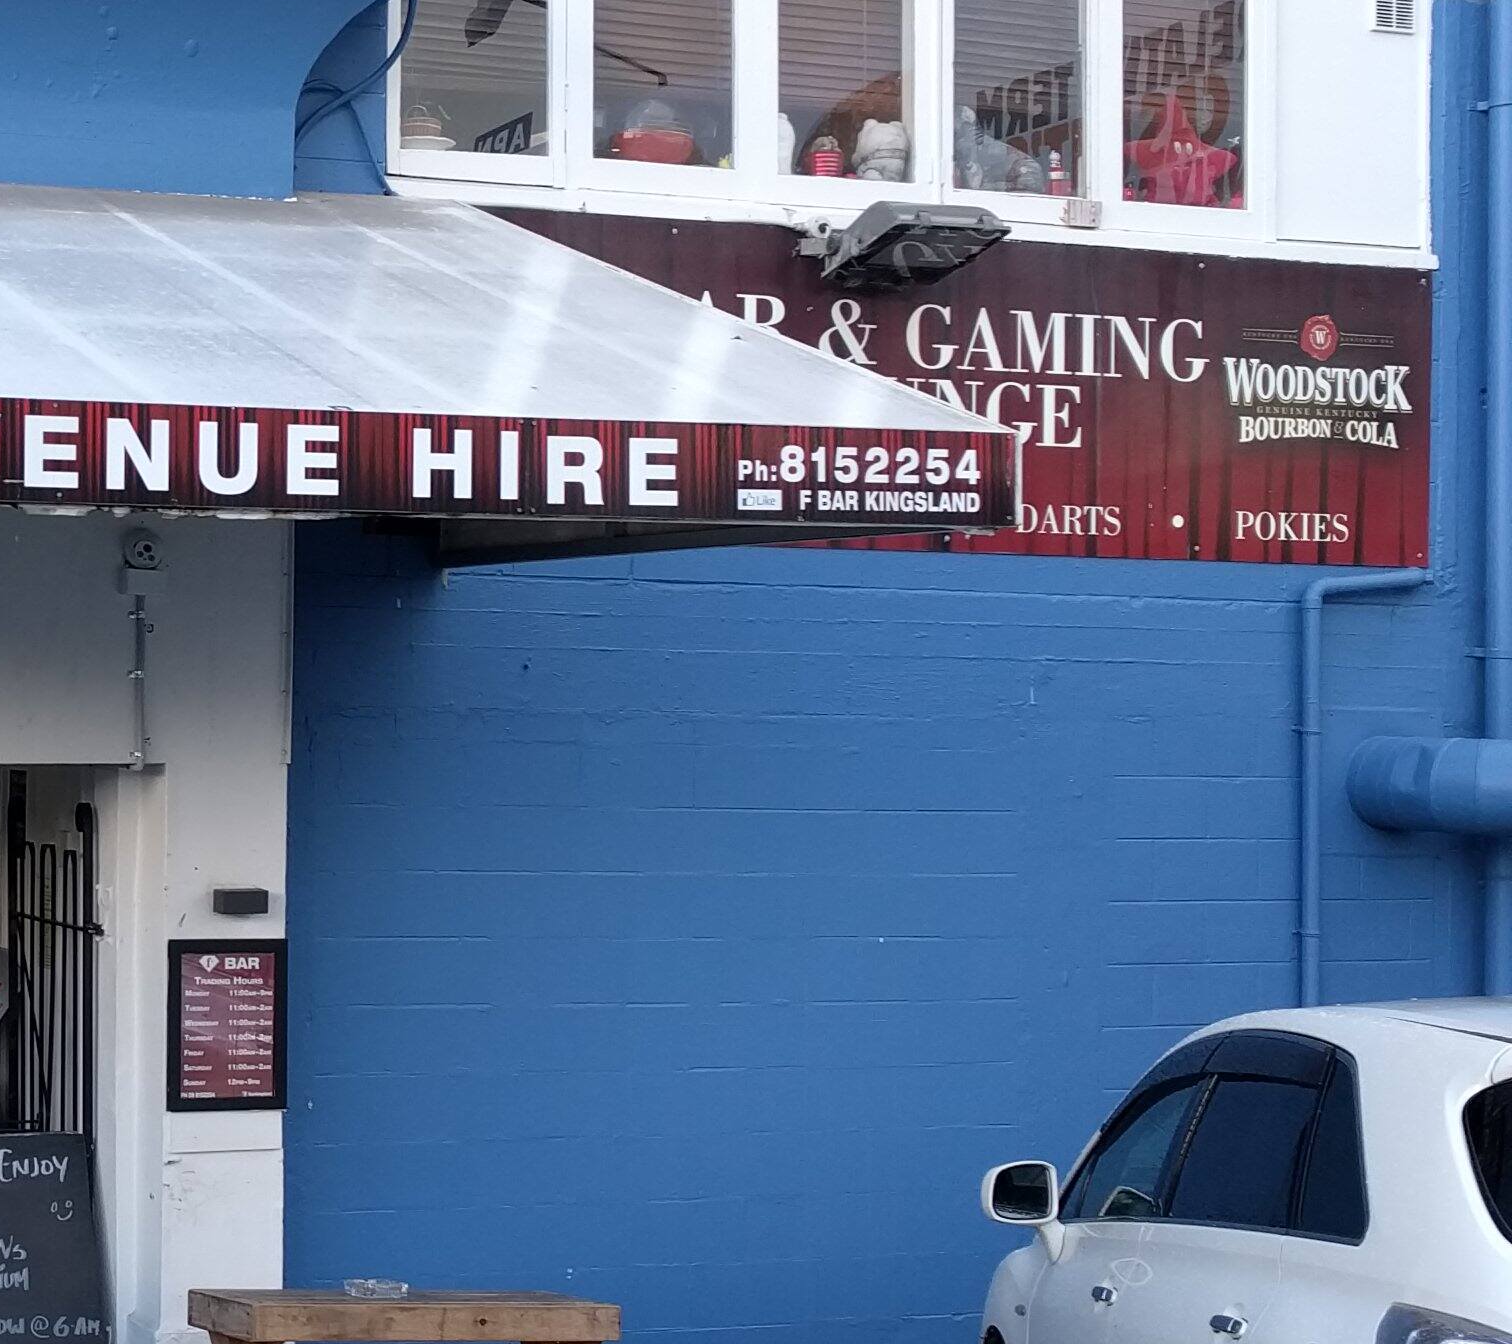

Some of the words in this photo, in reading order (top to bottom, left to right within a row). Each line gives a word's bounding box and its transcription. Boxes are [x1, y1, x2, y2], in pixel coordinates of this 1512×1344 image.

[818, 299, 878, 366] &
[906, 304, 1210, 382] GAMING
[1222, 357, 1413, 413] WOODSTOCK
[906, 377, 1082, 448] NGE
[1256, 406, 1310, 416] GENUINE
[1316, 407, 1378, 419] KENTUCKY
[1239, 416, 1332, 443] BOURBON
[1345, 420, 1399, 449] COLA
[413, 428, 678, 507] HIRE
[799, 490, 811, 510] F
[818, 490, 859, 511] BAR
[865, 491, 981, 513] KINGSLAND
[1016, 503, 1122, 537] DARTS
[1235, 510, 1350, 544] POKIES
[225, 957, 260, 969] BAR
[30, 1315, 50, 1339] @
